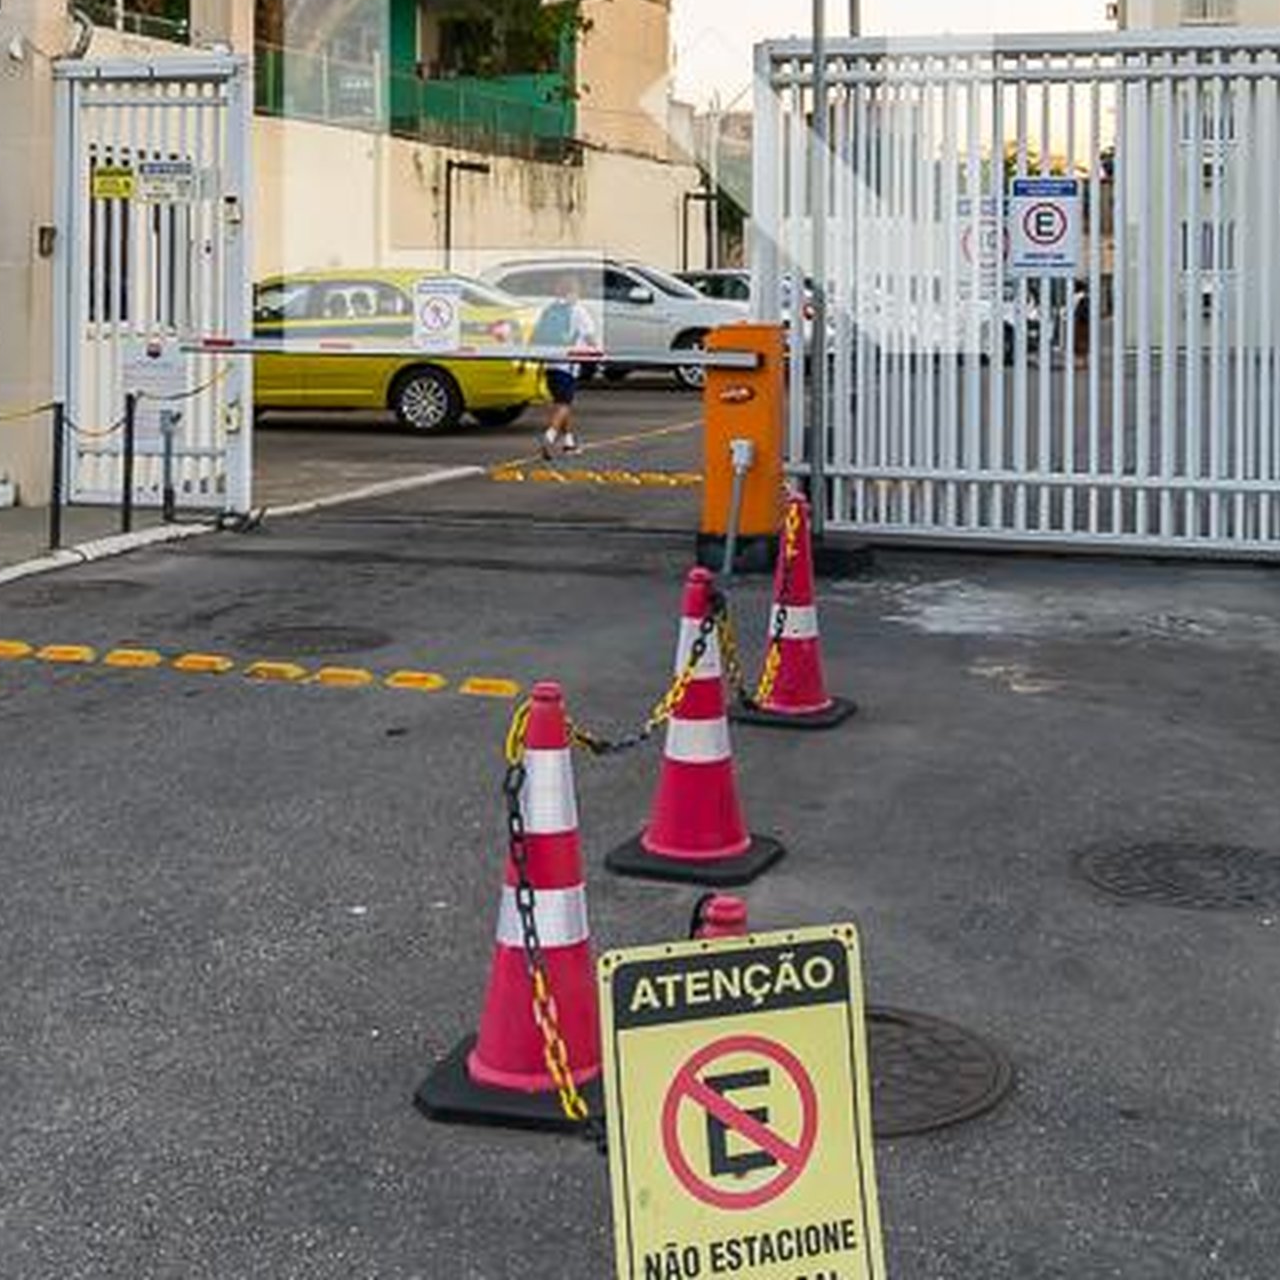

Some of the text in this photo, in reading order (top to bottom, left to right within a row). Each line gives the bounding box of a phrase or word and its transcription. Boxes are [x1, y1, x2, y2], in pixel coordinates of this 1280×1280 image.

[1035, 212, 1054, 237] E
[629, 953, 834, 1012] ATENÇÃO
[704, 1068, 778, 1177] E
[644, 1219, 858, 1280] NÃO ESTACIONE
